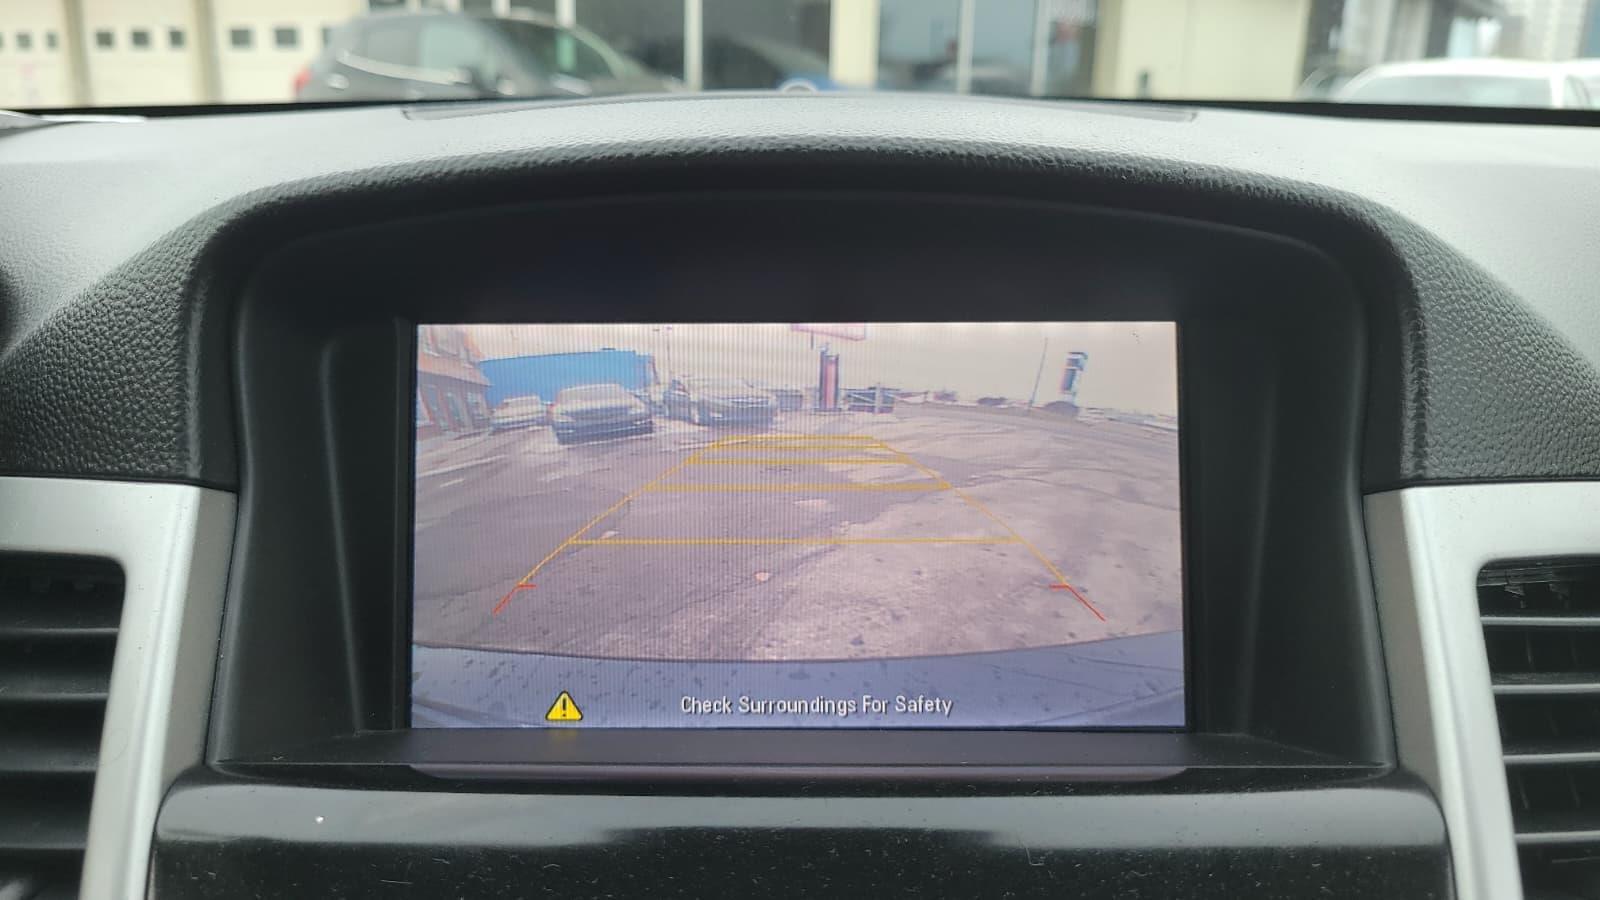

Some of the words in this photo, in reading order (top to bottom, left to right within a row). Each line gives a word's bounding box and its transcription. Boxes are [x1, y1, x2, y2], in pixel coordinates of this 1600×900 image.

[680, 695, 733, 714] Check
[738, 695, 857, 717] Surroundings
[862, 695, 889, 714] For
[894, 695, 953, 717] Safety
